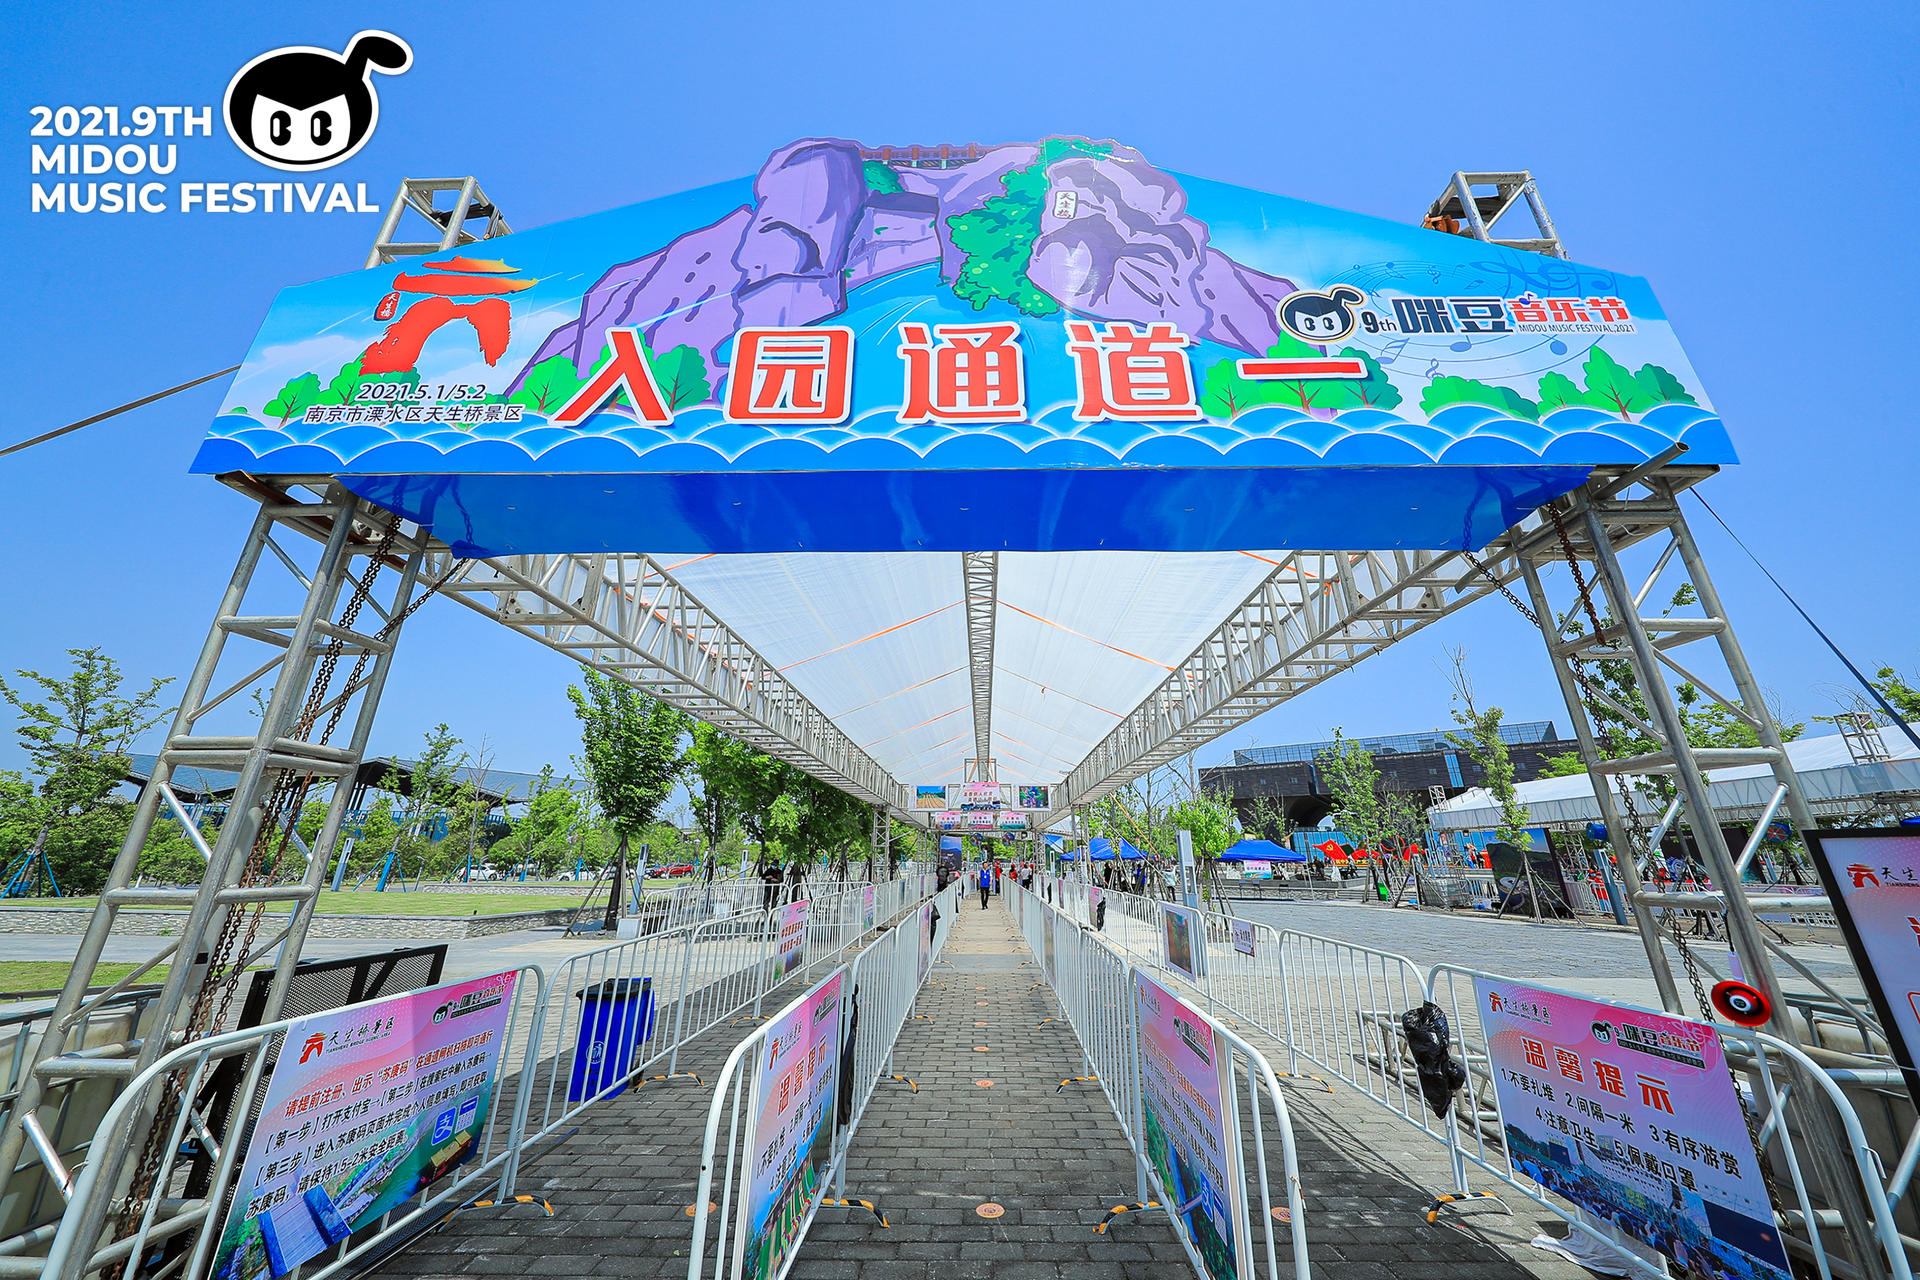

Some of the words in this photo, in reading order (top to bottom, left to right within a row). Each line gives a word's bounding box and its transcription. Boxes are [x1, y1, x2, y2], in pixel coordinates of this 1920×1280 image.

[1363, 311, 1397, 333] 9th
[1519, 325, 1548, 333] MIDOU
[1549, 325, 1575, 333] MUSIC
[357, 384, 487, 400] 2021.5.1/5.2
[552, 323, 1367, 425] 入园通道一
[304, 405, 523, 423] 南京市溧水区天生桥景区
[1520, 1035, 1676, 1116] 温馨提示
[1500, 1067, 1556, 1104] 1.不要扎堆
[1565, 1091, 1636, 1135] 2.间隔一米
[1649, 1124, 1743, 1181] 3.有序游赏
[1535, 1105, 1598, 1150] 4.注意卫生
[1613, 1140, 1699, 1194] 5.佩戴口罩
